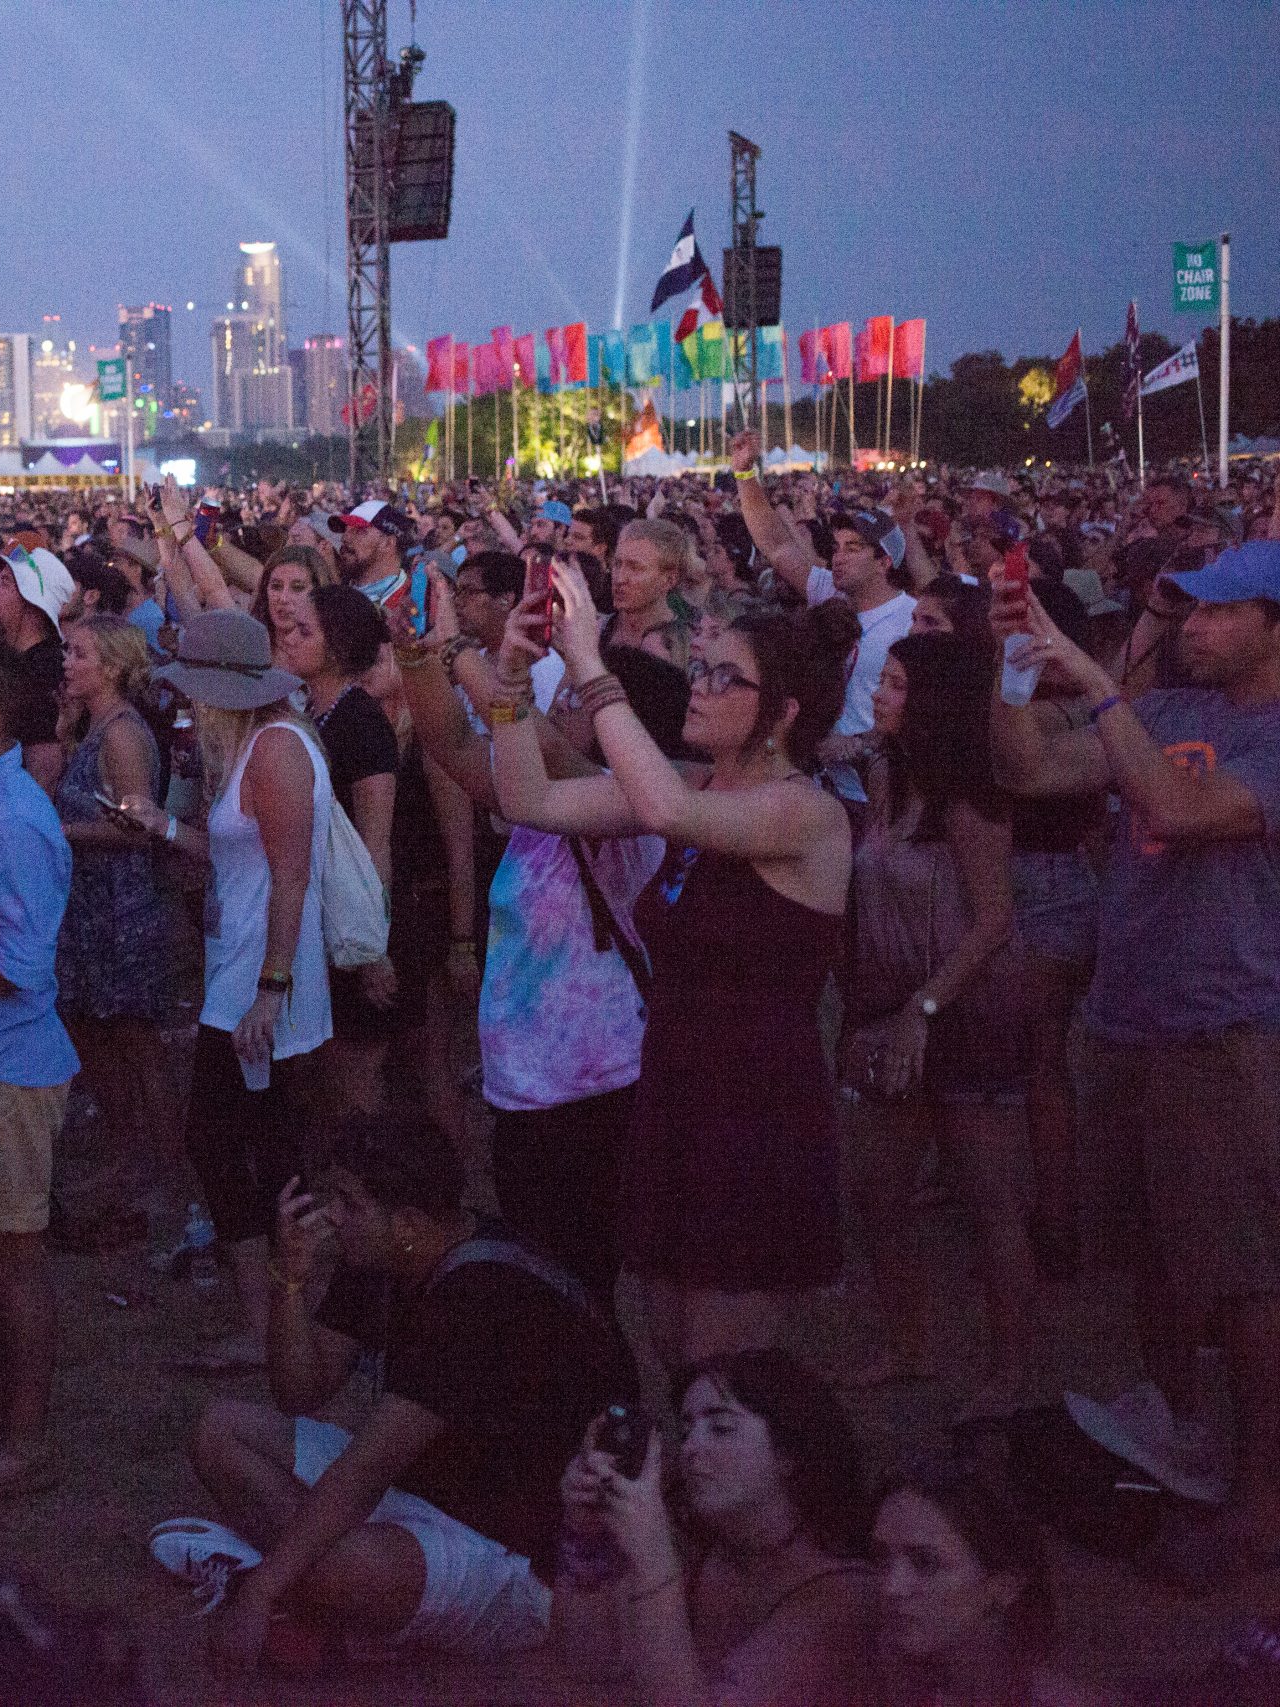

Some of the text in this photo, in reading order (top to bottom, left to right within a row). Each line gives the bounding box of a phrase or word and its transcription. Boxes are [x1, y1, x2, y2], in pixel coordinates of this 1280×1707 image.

[1186, 254, 1202, 267] NO
[1177, 268, 1214, 284] CHAIR
[1180, 285, 1211, 301] ZONE
